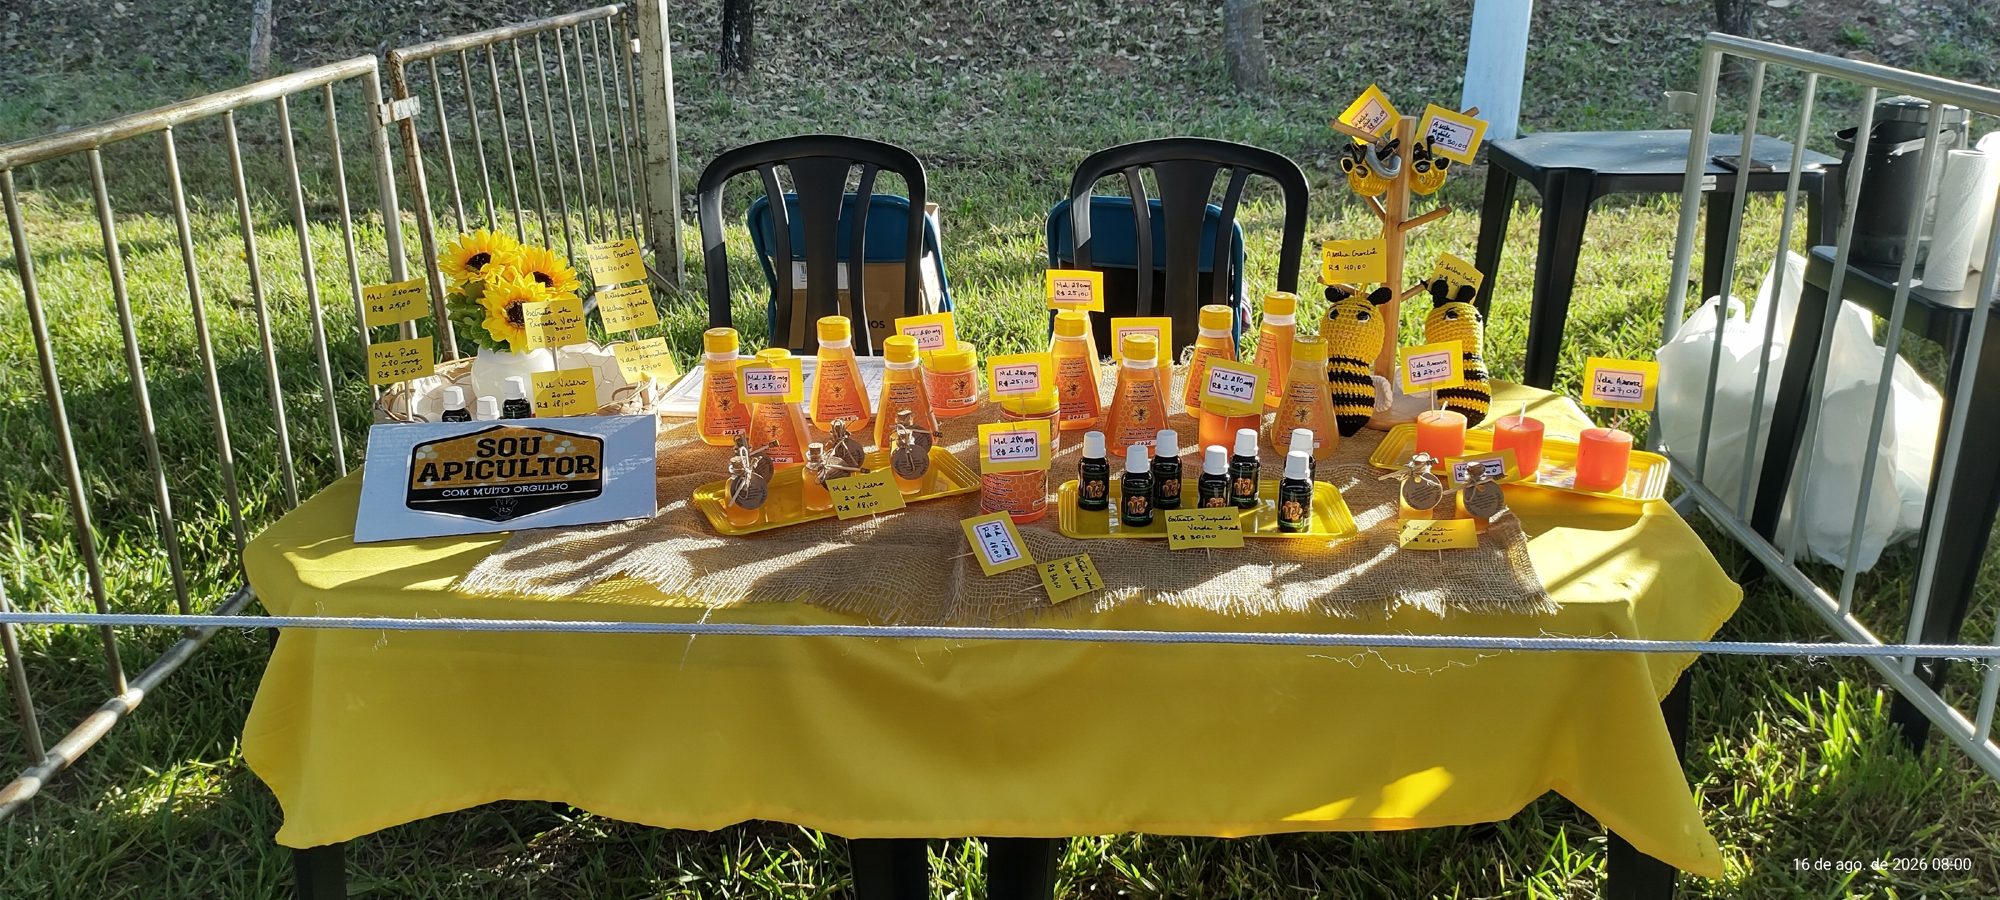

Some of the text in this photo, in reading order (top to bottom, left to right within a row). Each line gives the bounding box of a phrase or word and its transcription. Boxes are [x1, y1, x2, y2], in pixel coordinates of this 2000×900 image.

[1343, 263, 1367, 271] 40,00
[366, 293, 384, 301] Mel
[373, 352, 394, 360] Mel
[377, 370, 389, 378] R$
[1424, 367, 1447, 375] 27,00
[1223, 384, 1244, 394] 25,00
[1610, 387, 1639, 395] 27,00
[476, 437, 542, 458] SOU
[996, 445, 1034, 456] R$ 25,00
[417, 455, 597, 483] APICULTOR
[442, 483, 569, 497] COM MUITO ORGULHO
